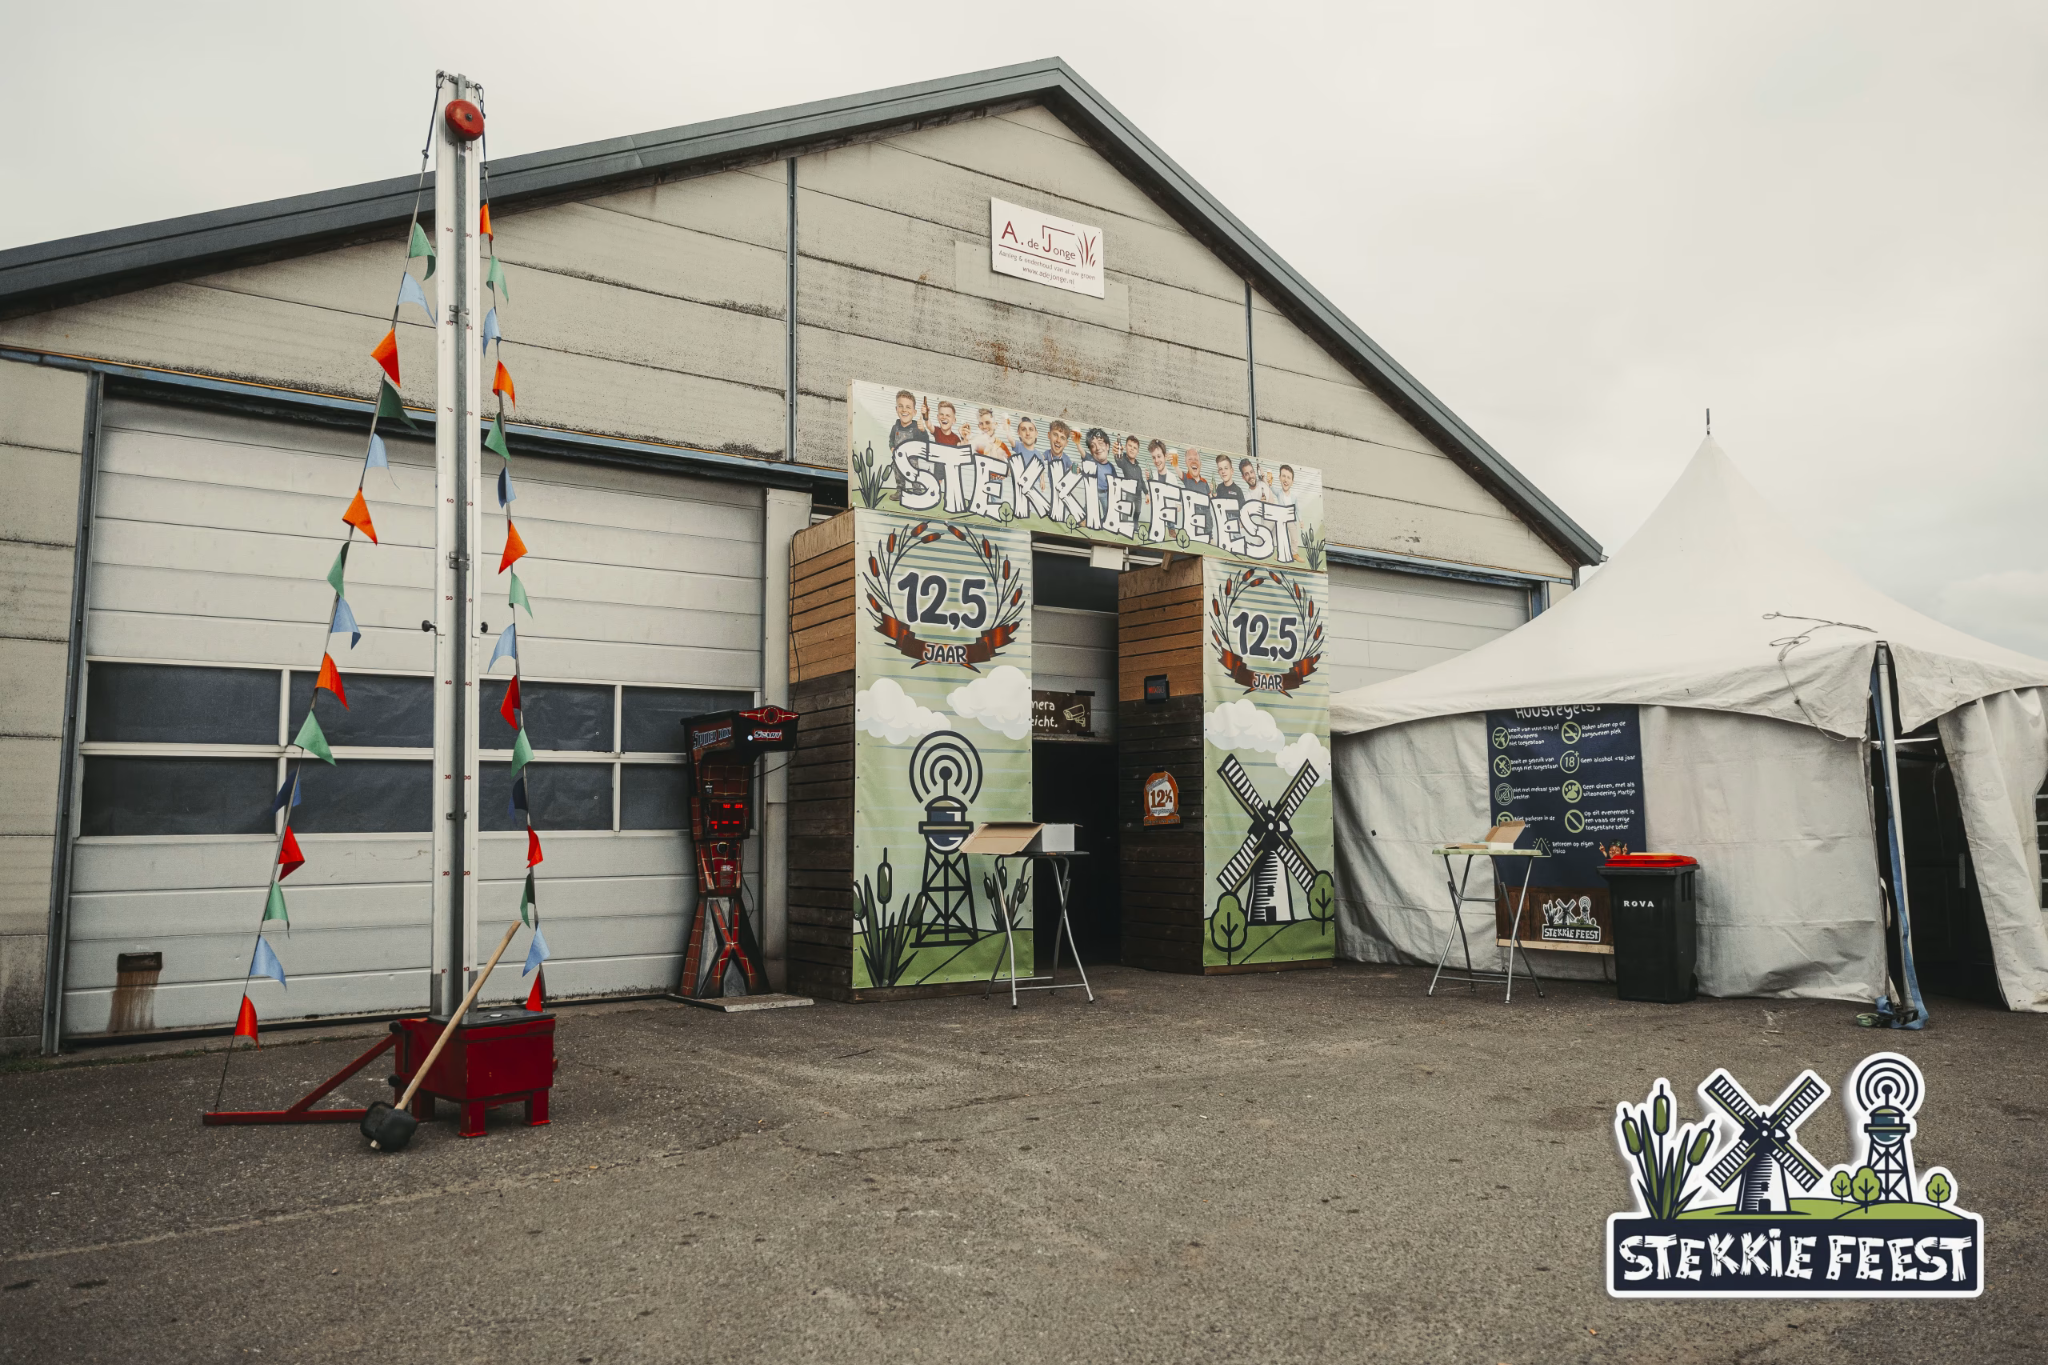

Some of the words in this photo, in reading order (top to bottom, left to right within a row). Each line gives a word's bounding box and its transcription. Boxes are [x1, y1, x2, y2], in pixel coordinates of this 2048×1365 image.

[1027, 238, 1040, 250] de
[1042, 233, 1076, 260] Jonge
[1024, 257, 1053, 270] onderhoud
[1080, 273, 1096, 281] groen
[1148, 479, 1296, 563] FEEST
[898, 572, 988, 630] 12,5
[1232, 611, 1298, 661] 12,5
[924, 643, 968, 664] JAAR
[1253, 673, 1284, 692] JAAR
[1623, 900, 1655, 908] ROVA
[1575, 928, 1599, 940] FEEST
